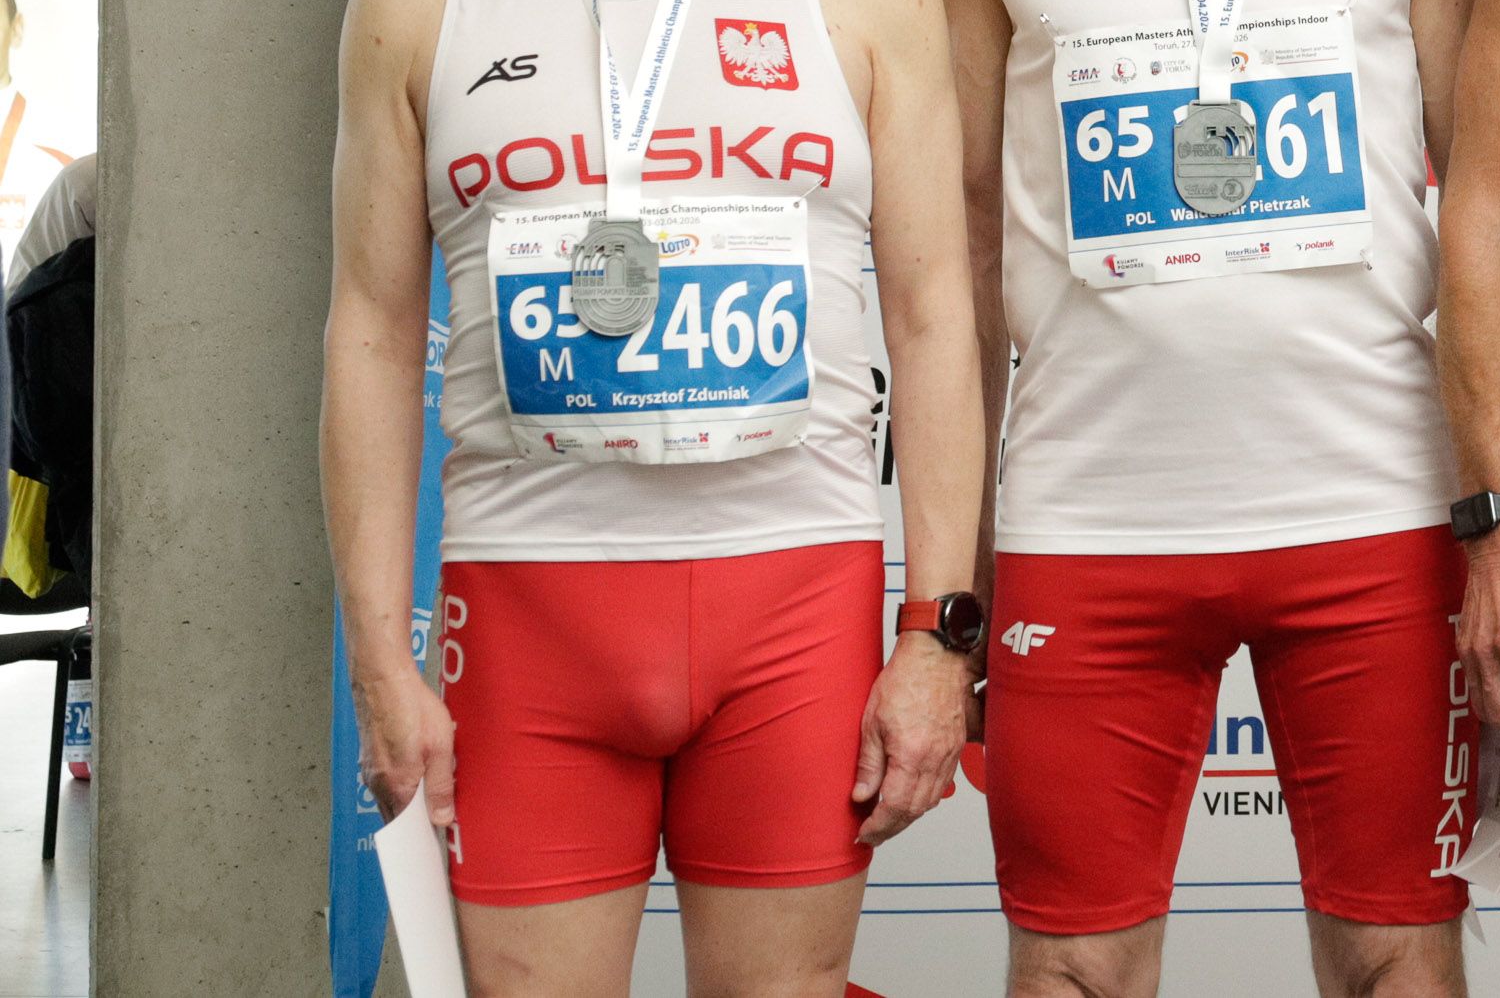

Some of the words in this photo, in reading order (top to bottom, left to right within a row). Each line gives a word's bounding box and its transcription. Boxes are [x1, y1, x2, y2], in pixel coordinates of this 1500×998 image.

[1072, 40, 1085, 48] 15.
[1086, 35, 1134, 47] European
[1135, 31, 1174, 41] Masters
[1298, 14, 1328, 24] Indoor
[632, 98, 650, 138] European
[644, 65, 662, 99] Masters
[654, 28, 673, 65] Athletics
[1076, 105, 1153, 163] 65
[448, 126, 834, 209] POLSKA
[1103, 167, 1136, 202] M
[532, 212, 580, 223] European
[671, 204, 750, 215] Championships
[752, 204, 784, 213] Indoor
[1126, 212, 1155, 226] POL
[1250, 196, 1311, 214] Pietrzak
[661, 238, 690, 254] LOTTO
[1165, 253, 1201, 265] ANIRO
[1225, 248, 1259, 257] InterRisk
[539, 347, 574, 382] M
[566, 394, 596, 408] POL
[612, 388, 684, 408] Krzysztof
[687, 386, 749, 402] Zduniak
[604, 439, 638, 449] ANIRO
[1001, 621, 1056, 657] 4F
